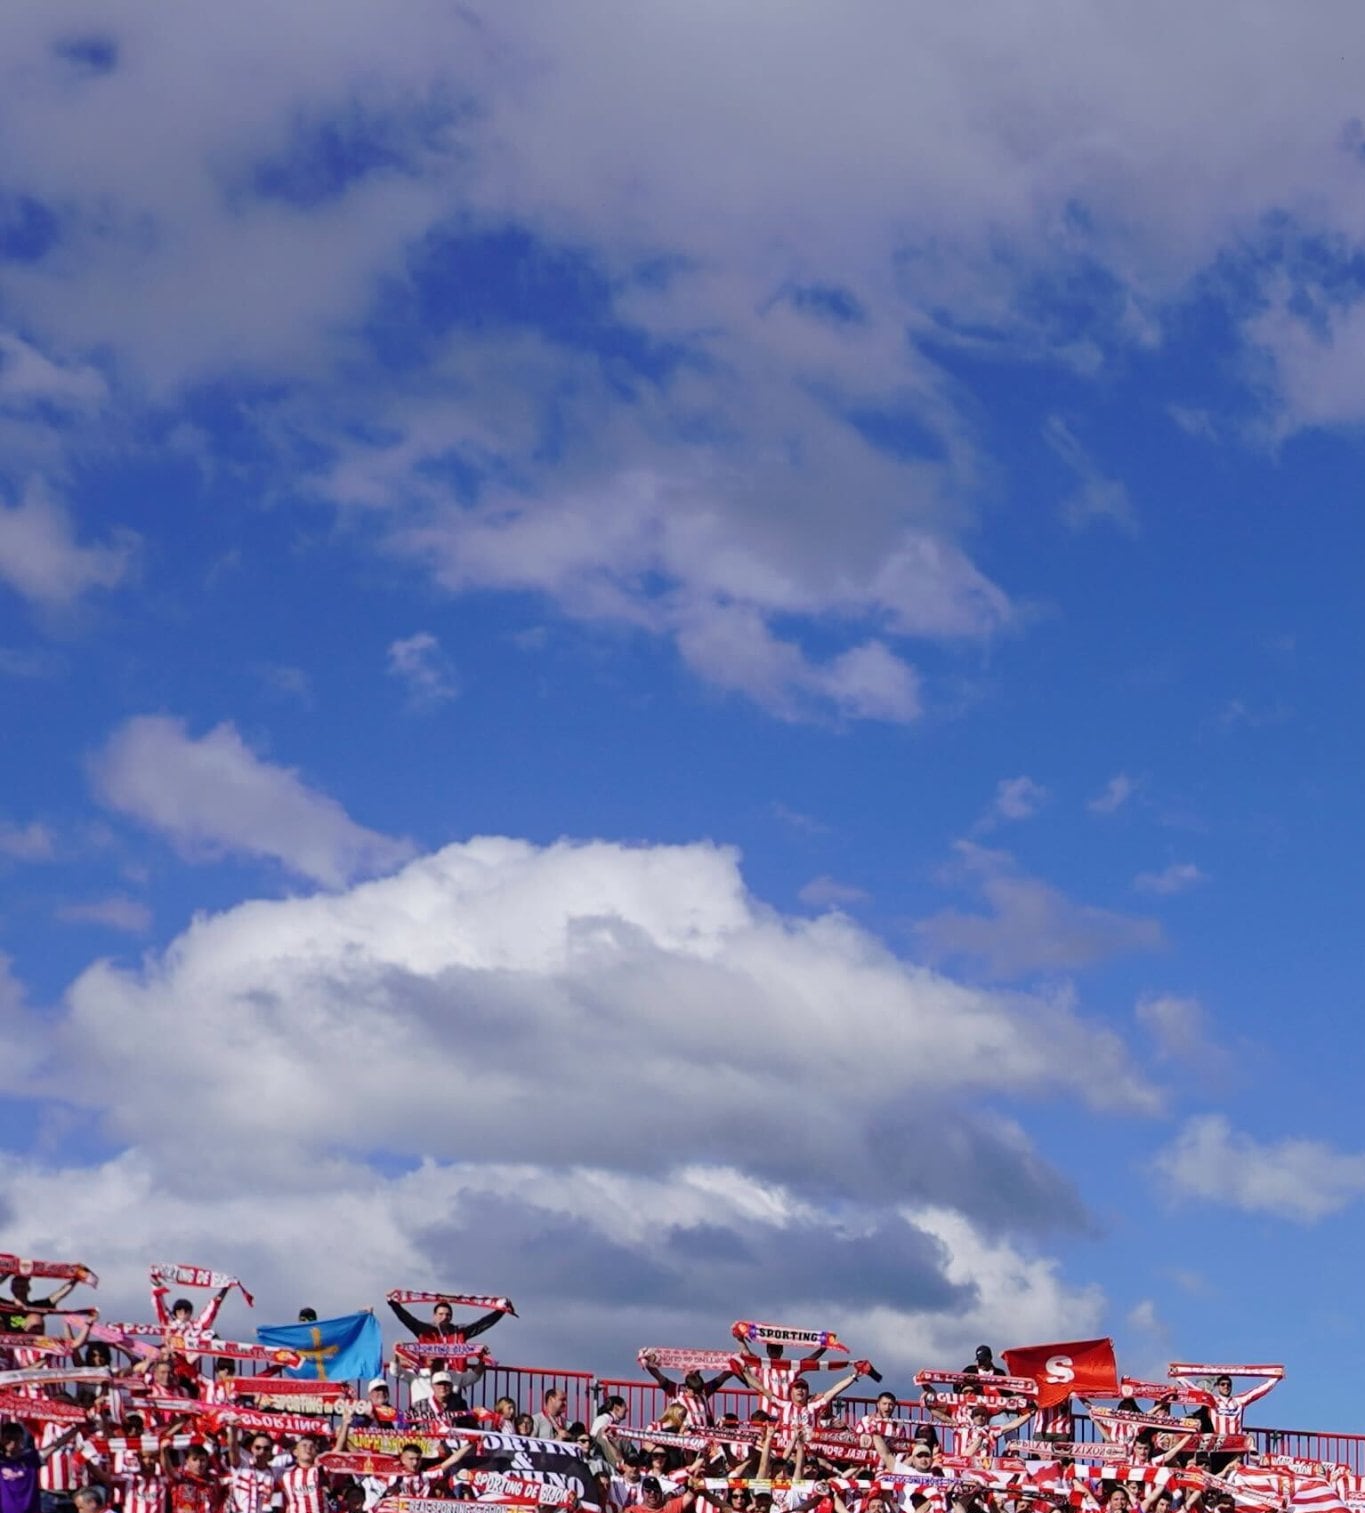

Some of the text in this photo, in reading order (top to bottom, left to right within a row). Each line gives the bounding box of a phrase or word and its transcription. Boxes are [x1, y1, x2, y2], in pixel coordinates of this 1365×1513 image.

[759, 1328, 819, 1342] SPORTING
[1045, 1355, 1075, 1384] S
[474, 1471, 522, 1497] SPORTING
[524, 1484, 540, 1498] DE
